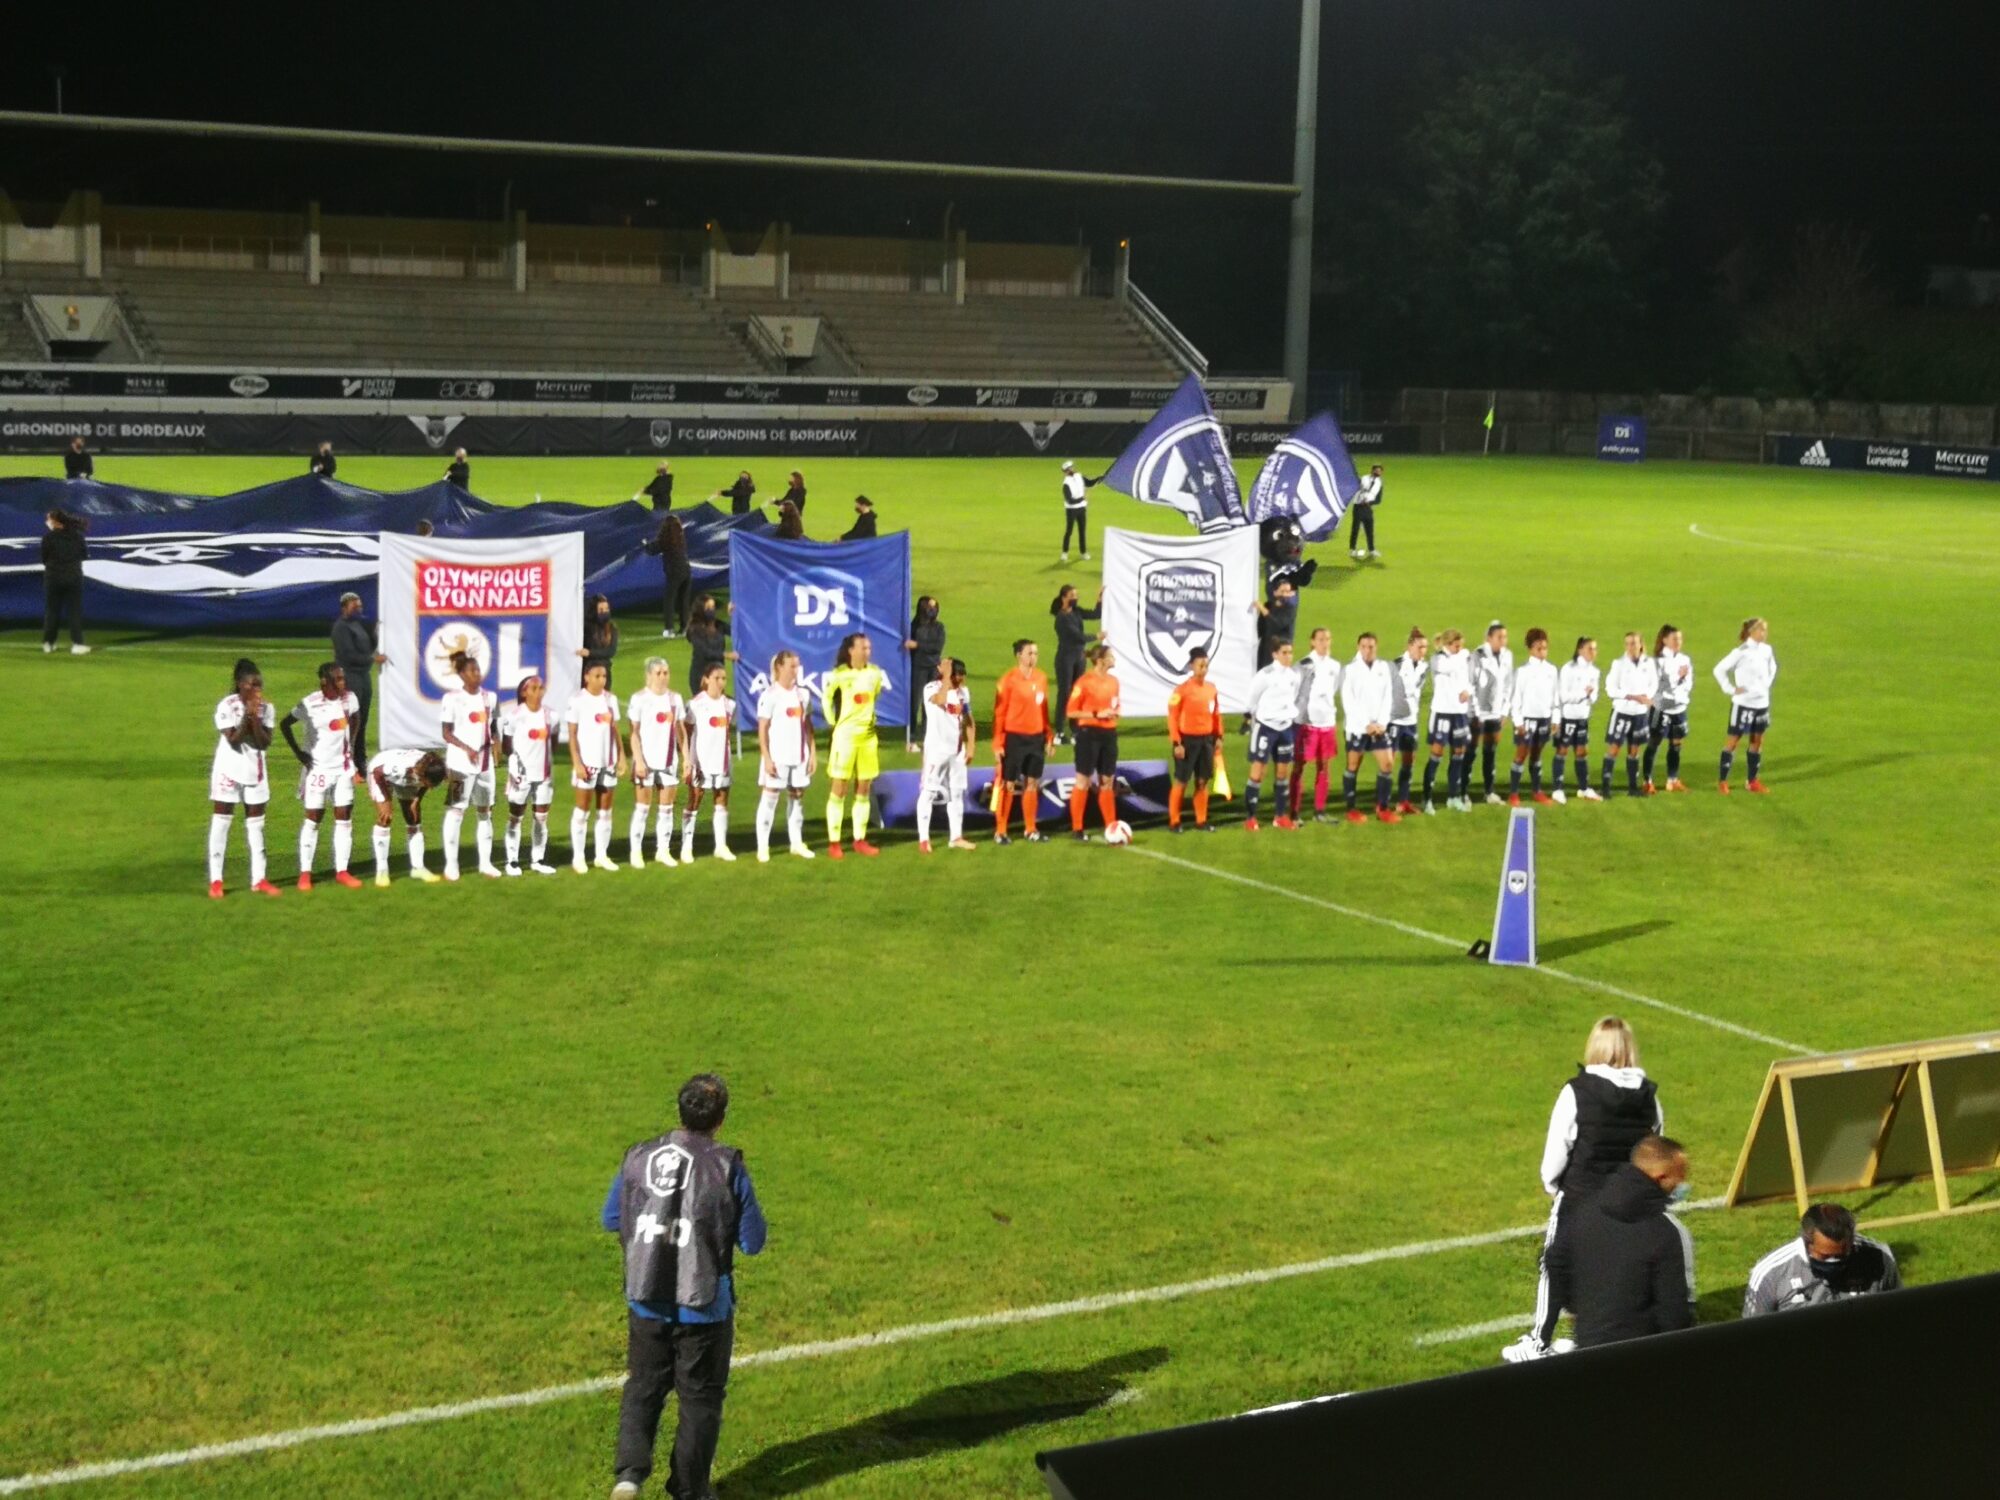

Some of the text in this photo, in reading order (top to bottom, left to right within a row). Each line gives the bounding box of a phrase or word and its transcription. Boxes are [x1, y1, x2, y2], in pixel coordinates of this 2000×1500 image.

[536, 382, 592, 393] Mercure
[3, 424, 206, 437] GIRONDINS DE BORDEAUX
[678, 429, 857, 442] FC GIRONDINS DE BORDEAUX
[1236, 433, 1249, 443] FC
[1800, 457, 1831, 467] adidas
[1935, 450, 1989, 466] Mercure
[424, 567, 542, 588] OLYMPIQUE
[425, 588, 543, 608] LYONNAIS
[794, 585, 850, 626] D1
[311, 774, 326, 788] 28
